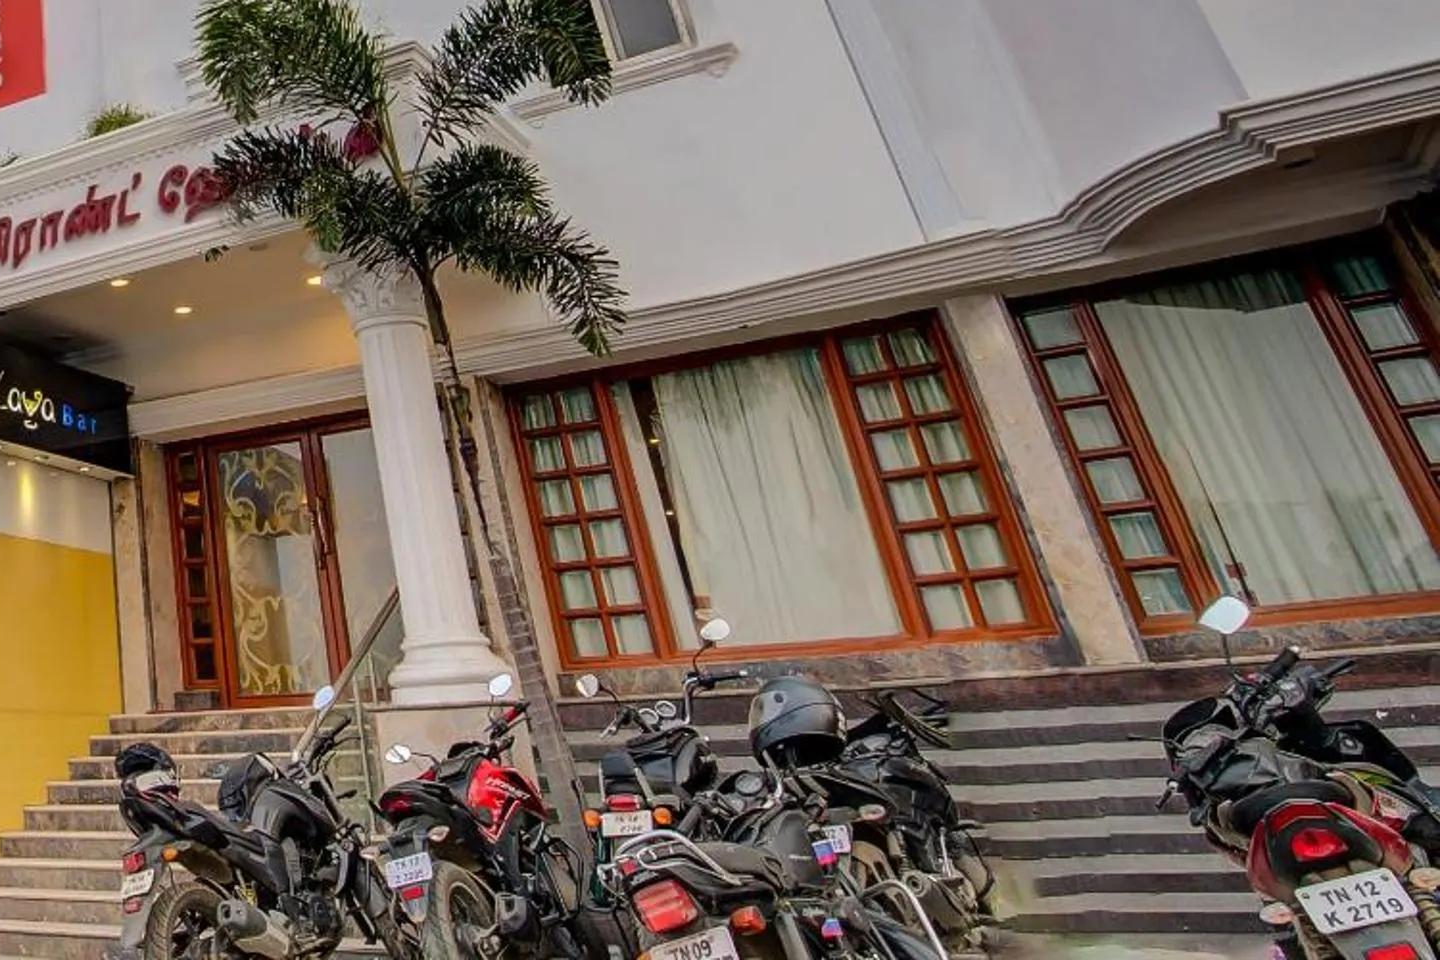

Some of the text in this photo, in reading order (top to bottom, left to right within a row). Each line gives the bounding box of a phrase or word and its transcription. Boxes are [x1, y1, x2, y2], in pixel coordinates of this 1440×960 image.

[62, 402, 98, 435] Bar
[1320, 880, 1382, 906] TN 12
[1322, 897, 1405, 928] K 2719
